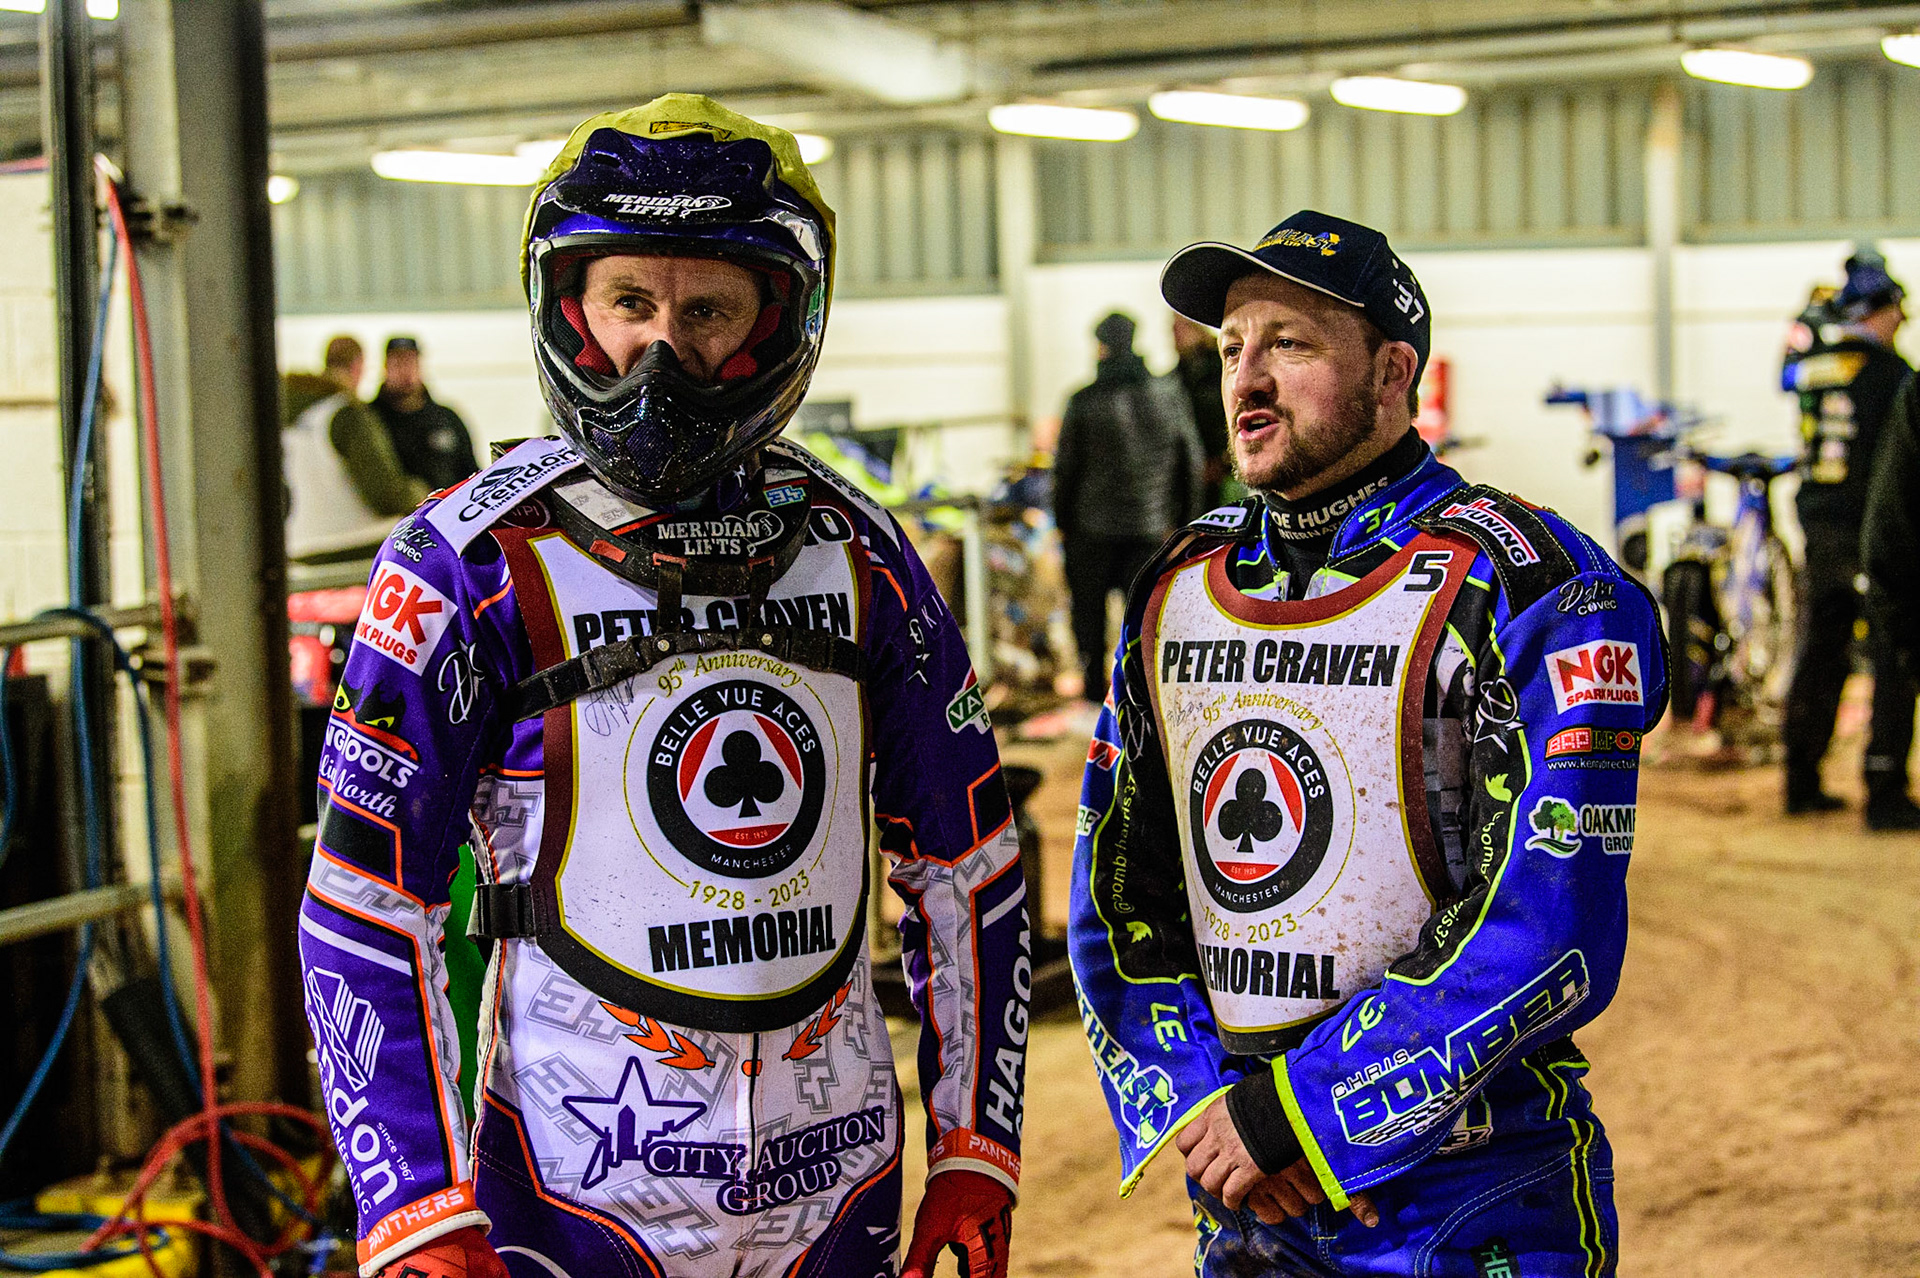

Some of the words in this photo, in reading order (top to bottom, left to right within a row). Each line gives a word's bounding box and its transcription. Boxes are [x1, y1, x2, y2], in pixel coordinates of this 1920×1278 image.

[602, 194, 706, 207] MERIDIAN
[617, 204, 679, 216] LIFTS
[458, 449, 580, 522] Crendon
[489, 489, 522, 511] TIMBER
[1270, 511, 1291, 529] OE
[1297, 476, 1388, 529] HUGHES
[656, 522, 760, 539] MERIDIAN
[683, 538, 741, 555] LIFTS
[1464, 508, 1529, 566] TUNING
[1404, 552, 1452, 592] 5
[573, 608, 694, 655] PETR
[706, 592, 850, 637] CAVEN
[1577, 599, 1617, 616] covec
[369, 627, 418, 665] PLUGS
[693, 651, 802, 688] Anniversary
[1162, 640, 1247, 684] PETER
[1253, 639, 1400, 687] CRAVEN
[1556, 645, 1637, 693] NGK
[655, 700, 708, 767] BELLE
[717, 687, 764, 707] VUE
[772, 702, 816, 753] ACES
[1230, 688, 1324, 731] Anniversary
[1193, 733, 1234, 794] BELLE
[1242, 726, 1282, 748] VUE
[1286, 744, 1325, 798] ACES
[711, 844, 793, 869] MANCHESTER
[689, 880, 745, 911] 1928
[768, 869, 811, 908] 2023
[1214, 882, 1280, 903] MANCHESTER
[648, 904, 836, 973] MEMORIAL
[1204, 906, 1230, 941] 1928
[1247, 912, 1298, 944] 2023
[1337, 950, 1588, 1140] BOMBER
[1332, 1049, 1408, 1099] CHRIS
[377, 1122, 398, 1154] since
[396, 1155, 415, 1182] 1967
[648, 1146, 742, 1175] CITY
[757, 1112, 884, 1172] AUCTION
[721, 1160, 839, 1214] GROUP
[368, 1187, 465, 1254] PANTHERS
